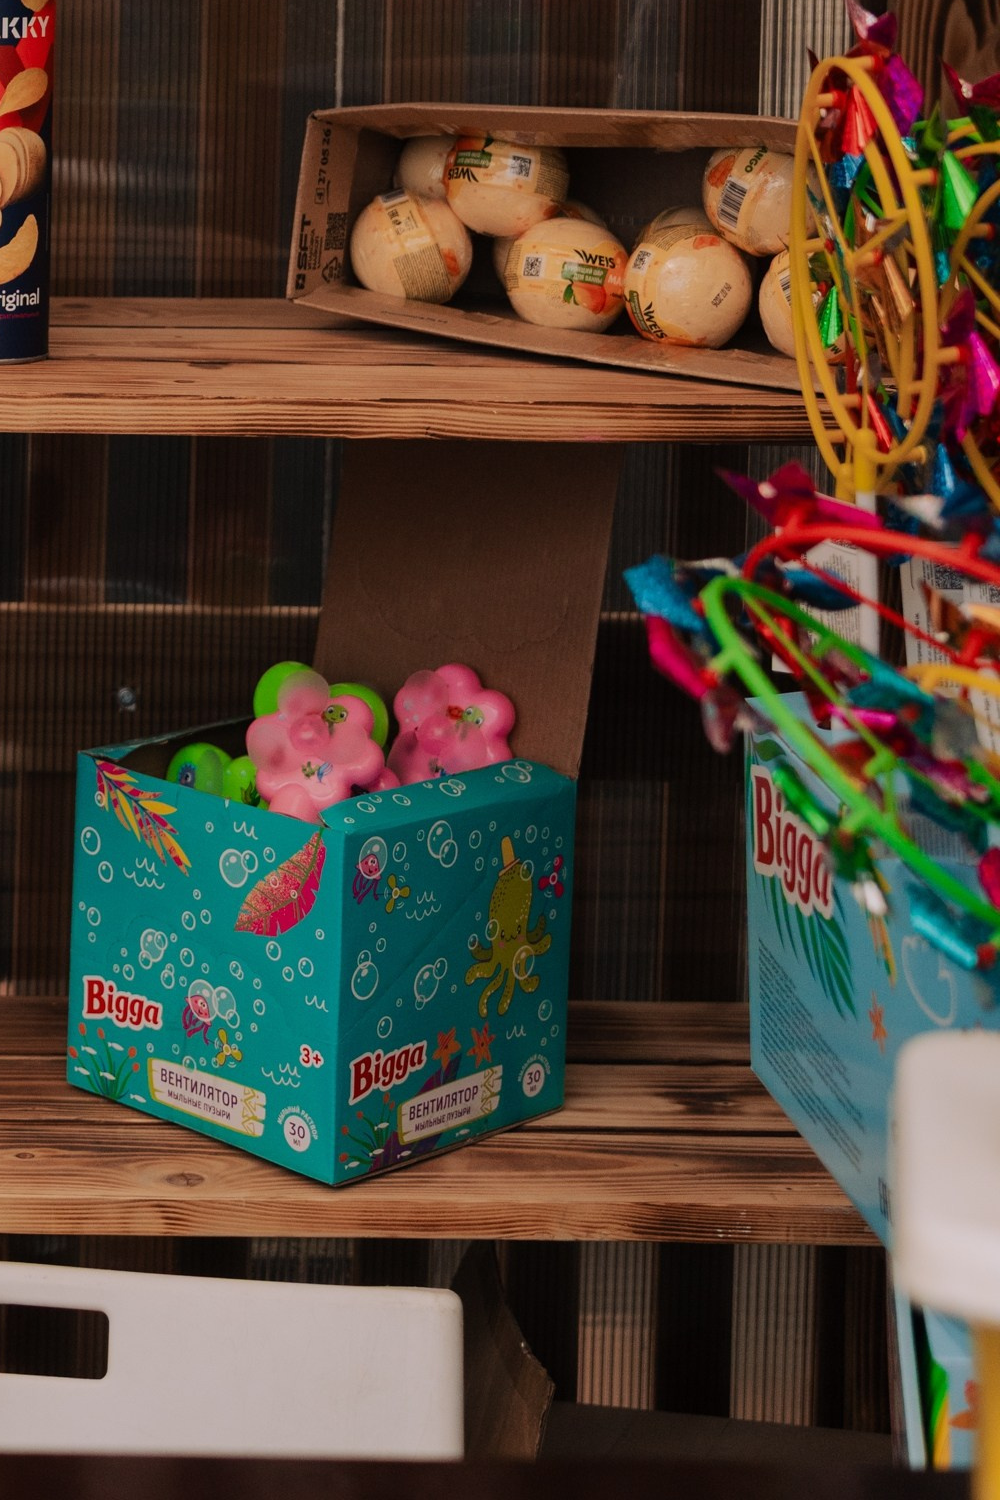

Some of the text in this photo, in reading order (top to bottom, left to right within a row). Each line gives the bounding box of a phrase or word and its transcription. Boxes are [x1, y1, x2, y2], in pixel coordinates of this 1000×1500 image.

[297, 213, 312, 271] SFT
[583, 250, 617, 269] WEIS
[85, 978, 160, 1027] Bigga
[301, 1047, 322, 1066] 3+
[352, 1043, 425, 1101] Bigga
[160, 1068, 239, 1109] ВЕНТИЛЯТОР
[527, 1069, 541, 1086] 30
[167, 1089, 231, 1121] МЫЛЬНЫЕ ПУЗЫРИ
[408, 1084, 479, 1121] ВЕНТИЛЯТОР
[288, 1122, 306, 1140] 30
[414, 1105, 471, 1133] МЫЛЬНЫЕ ПУЗЫРИ
